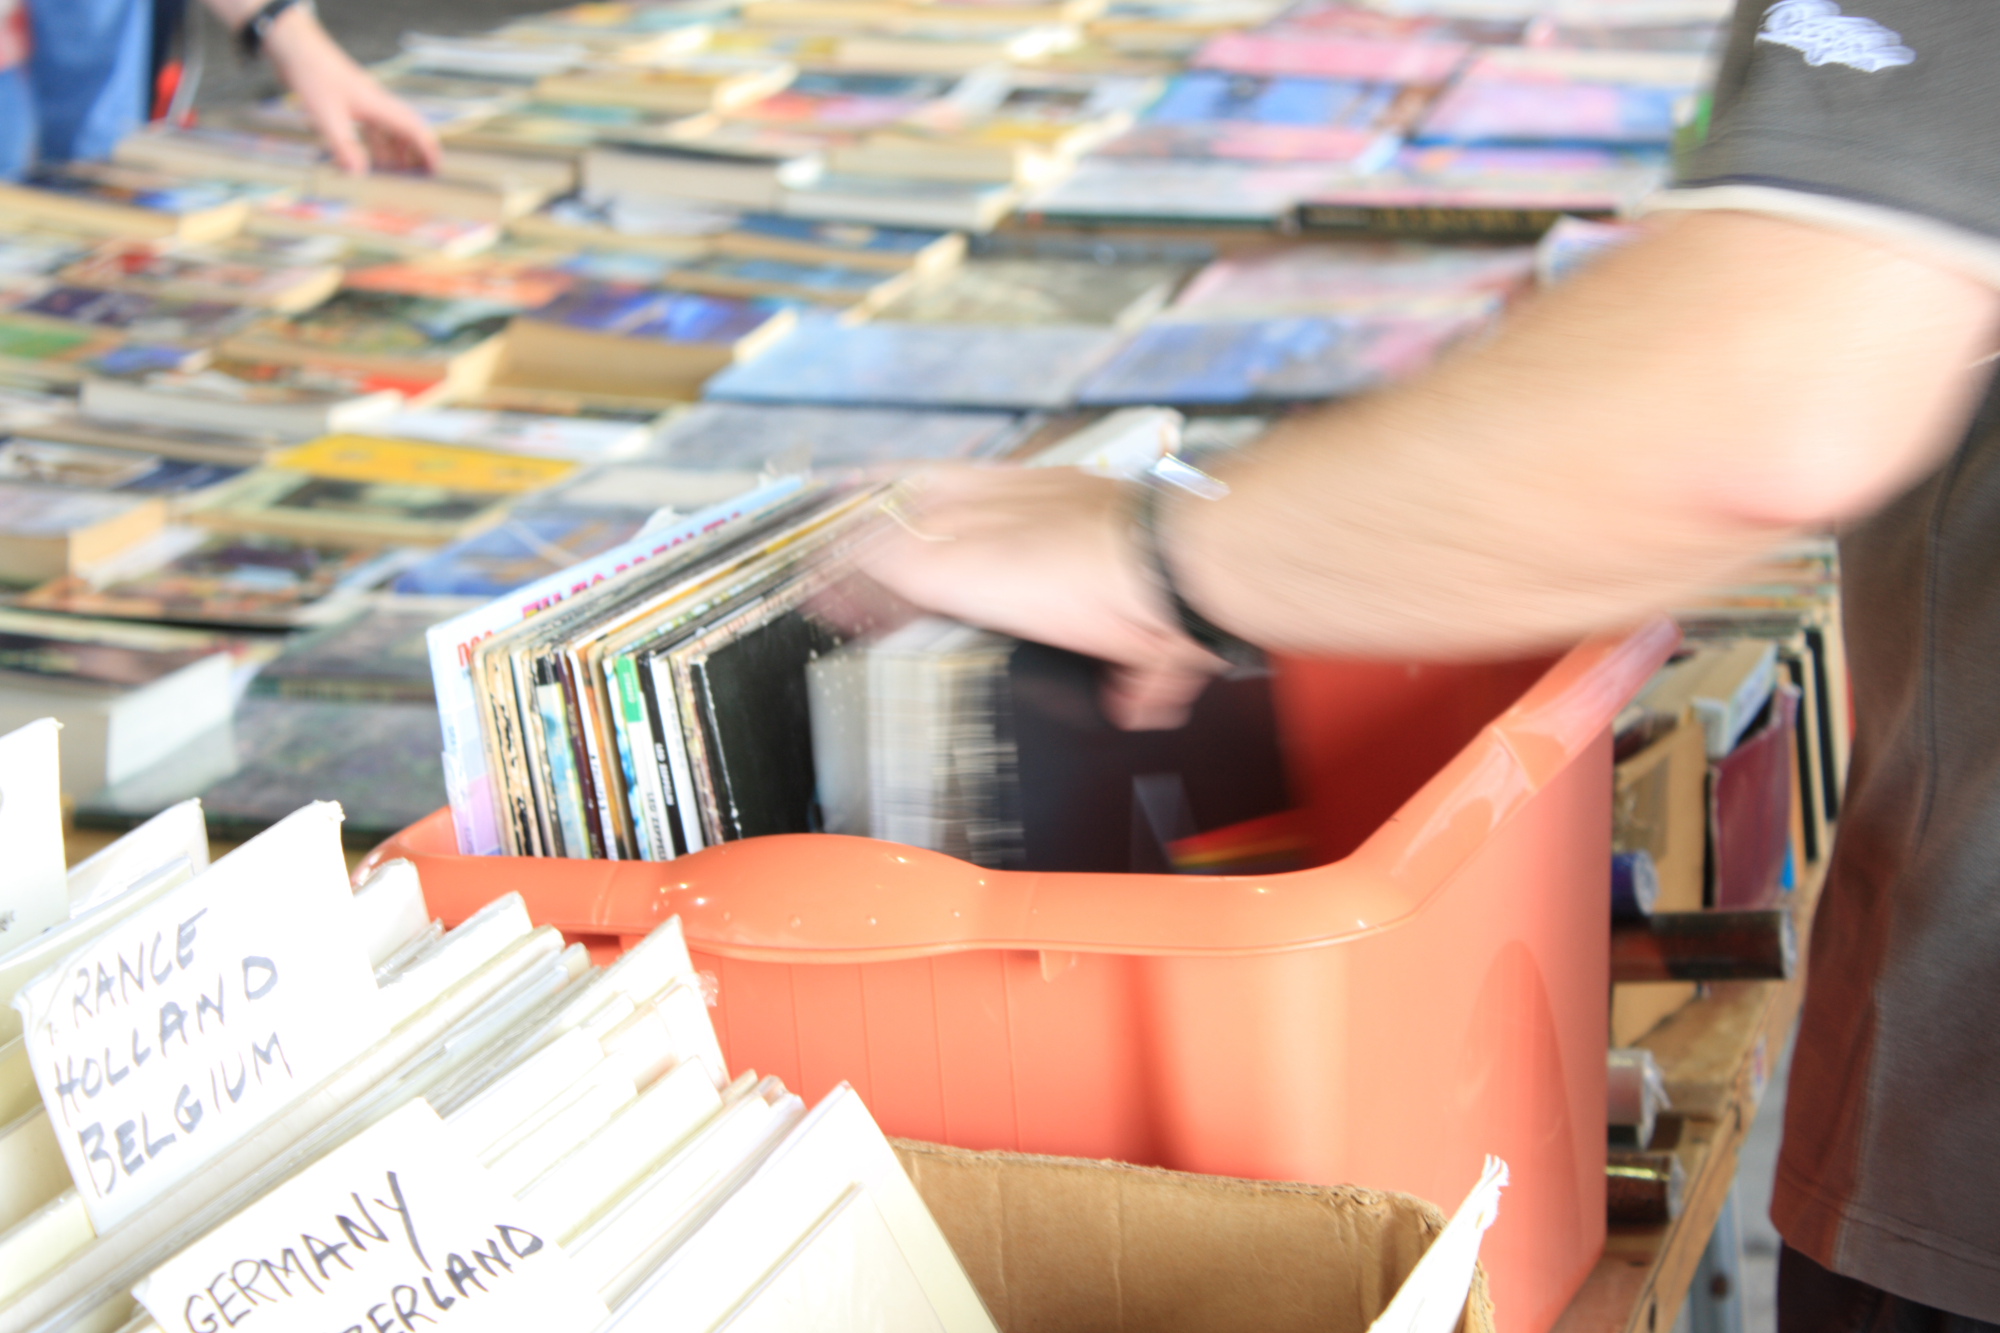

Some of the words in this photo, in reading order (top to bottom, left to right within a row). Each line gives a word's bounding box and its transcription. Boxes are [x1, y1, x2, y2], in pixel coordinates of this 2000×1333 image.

[655, 742, 667, 763] LED
[658, 762, 676, 807] ZEPPELIN
[48, 906, 208, 1047] RANCE
[54, 954, 279, 1129] HOLLAND
[77, 1031, 294, 1199] BELGIUM
[184, 1170, 434, 1333] GERMANY
[341, 1224, 545, 1333] ERLAND
